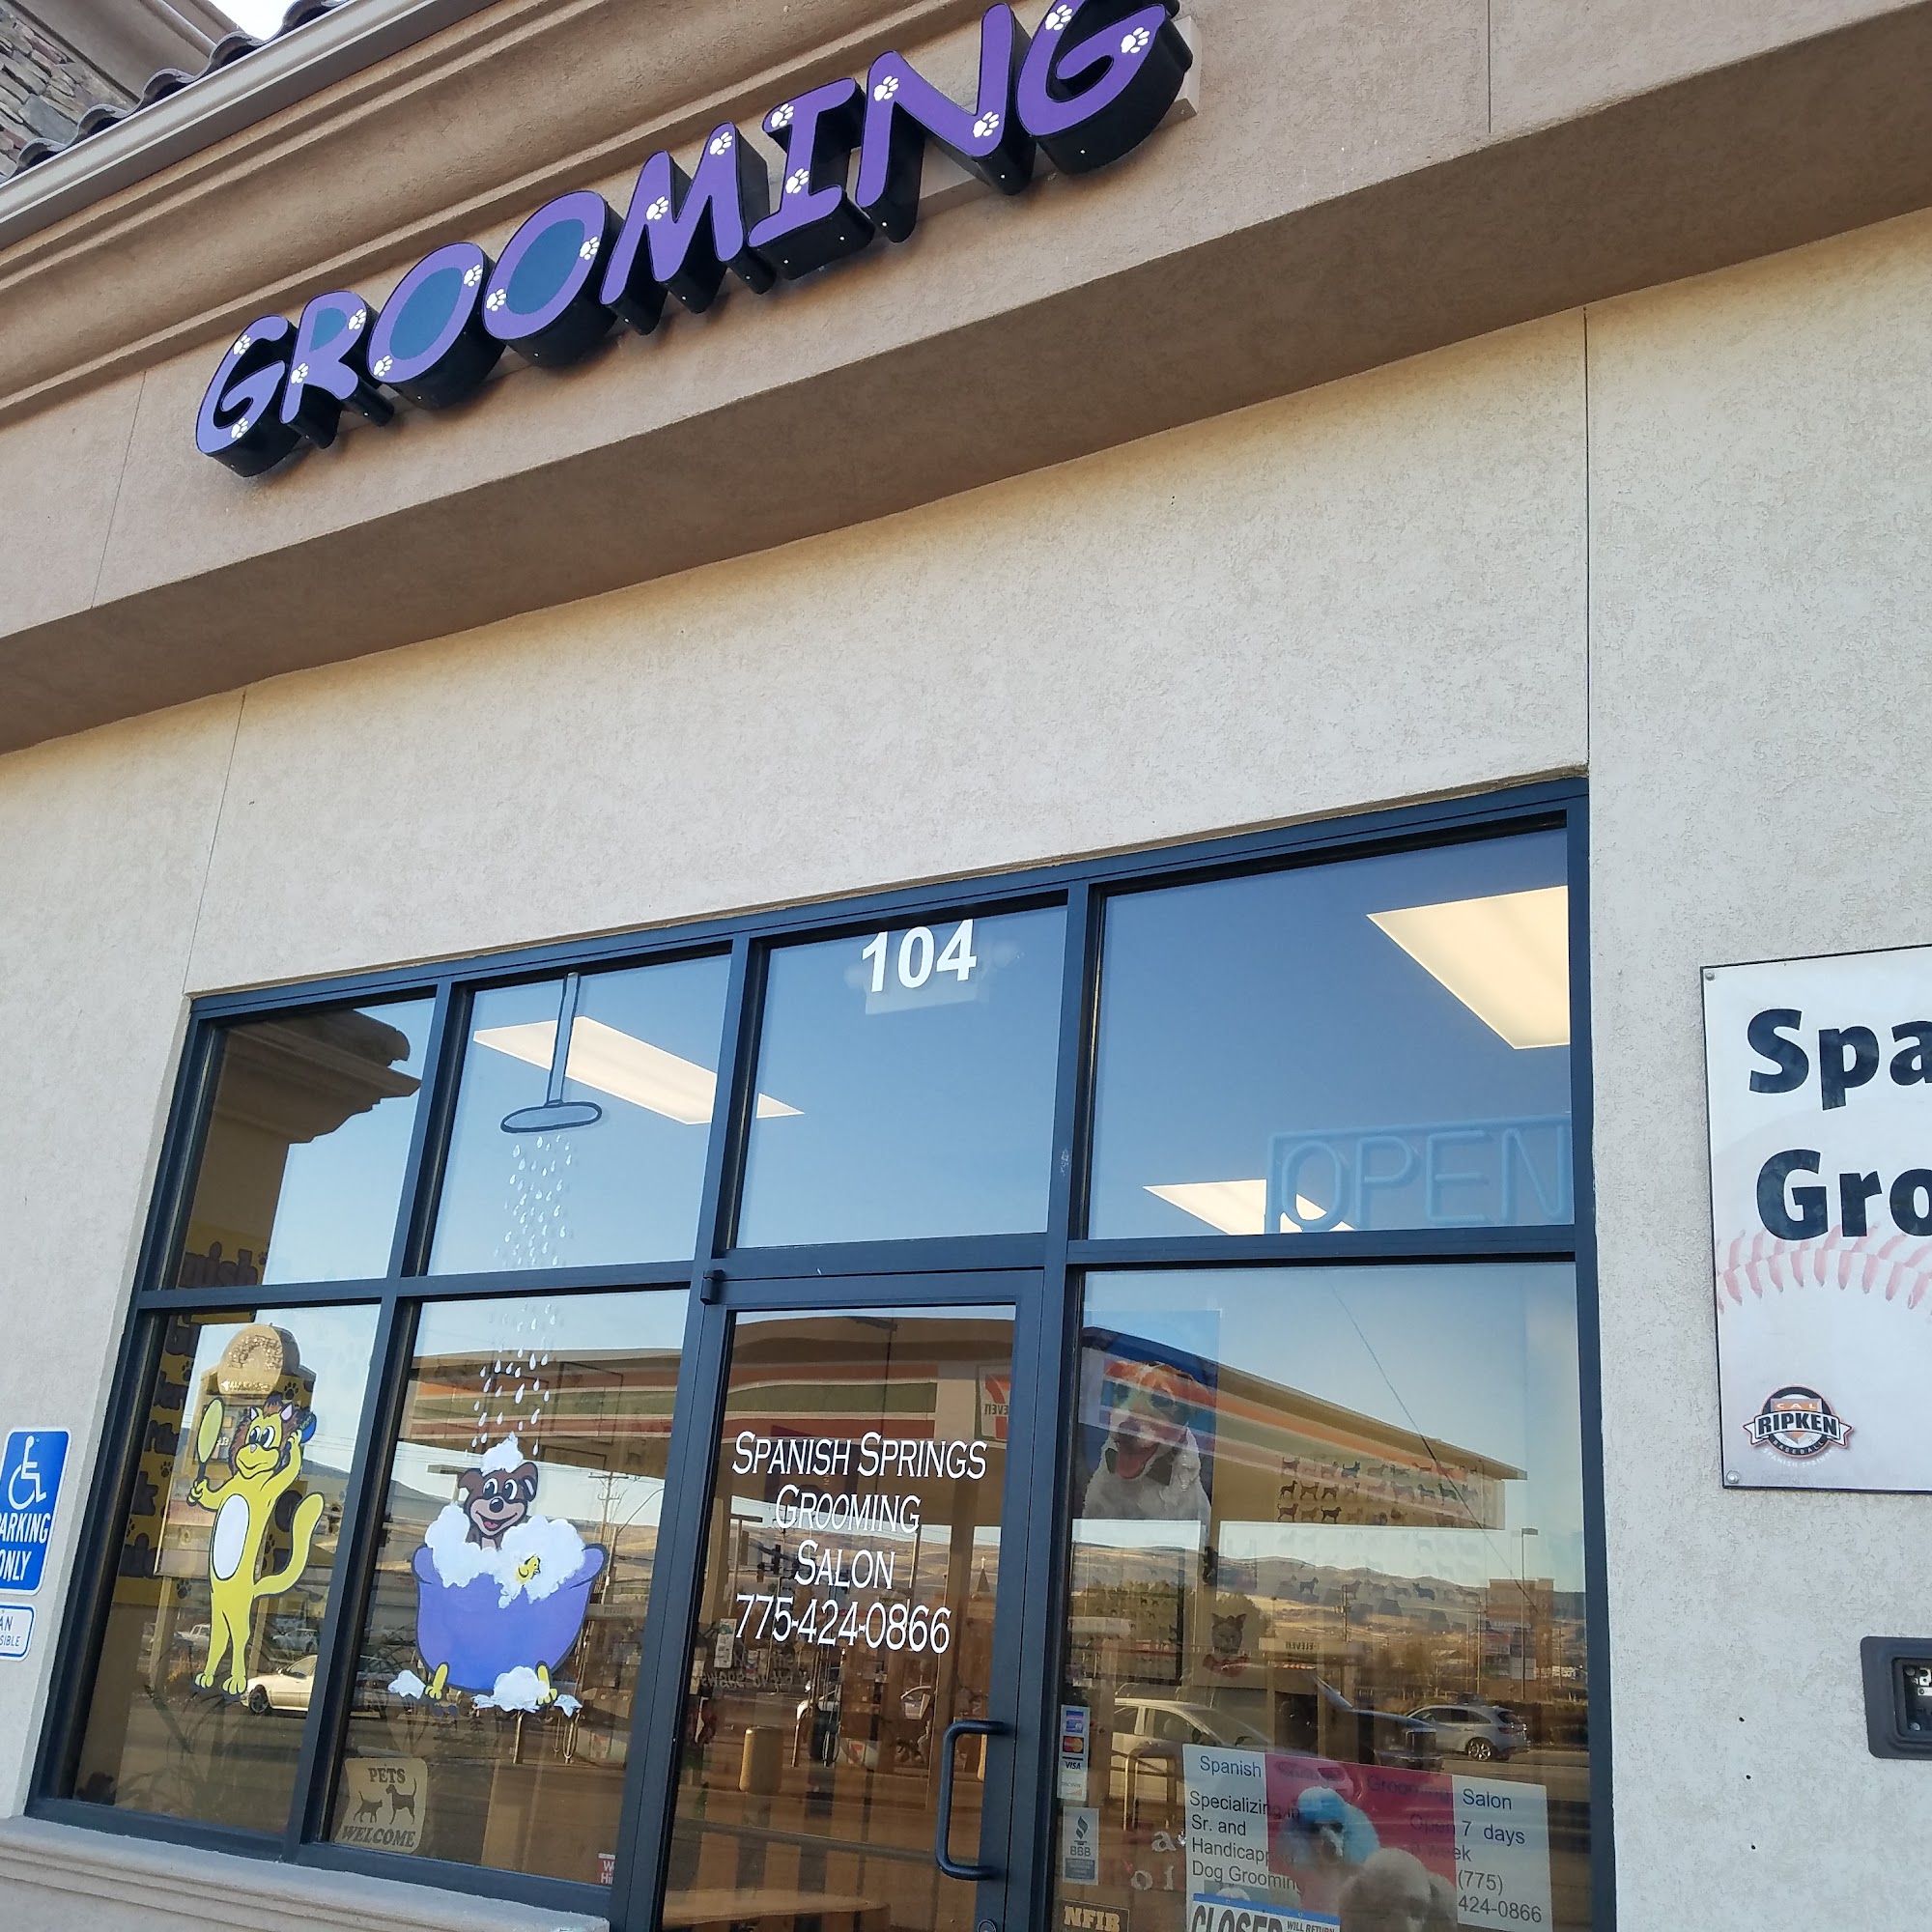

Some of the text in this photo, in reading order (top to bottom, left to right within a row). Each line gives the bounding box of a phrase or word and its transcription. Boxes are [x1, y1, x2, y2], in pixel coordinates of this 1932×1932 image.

[196, 0, 1174, 462] GROOMING
[862, 919, 978, 992] 104
[1747, 1008, 1932, 1111] Spa
[1279, 1125, 1569, 1231] OPEN
[1756, 1149, 1932, 1241] Gro
[1776, 1402, 1817, 1410] CAL
[1757, 1411, 1838, 1437] RIPKEN
[1763, 1447, 1798, 1468] SPANISH
[1772, 1438, 1825, 1456] BASEBALL
[0, 1512, 51, 1544] ARKING
[735, 1593, 952, 1654] 775-424-0866
[368, 1767, 406, 1784] PETS
[1065, 1761, 1081, 1770] VISA
[1200, 1755, 1262, 1778] Spanish
[1463, 1788, 1513, 1810] Salon
[341, 1825, 416, 1848] WELCOME
[1191, 1814, 1246, 1836] Sr. and
[1462, 1820, 1472, 1836] 7
[1483, 1824, 1525, 1847] days
[1069, 1845, 1092, 1858] BBB
[1192, 1837, 1269, 1867] Handicap
[1192, 1860, 1224, 1883] Dog
[1458, 1868, 1504, 1896] (775)
[1065, 1906, 1121, 1932] NFIB
[1458, 1894, 1543, 1923] 424-0866
[1287, 1920, 1304, 1931] WILL
